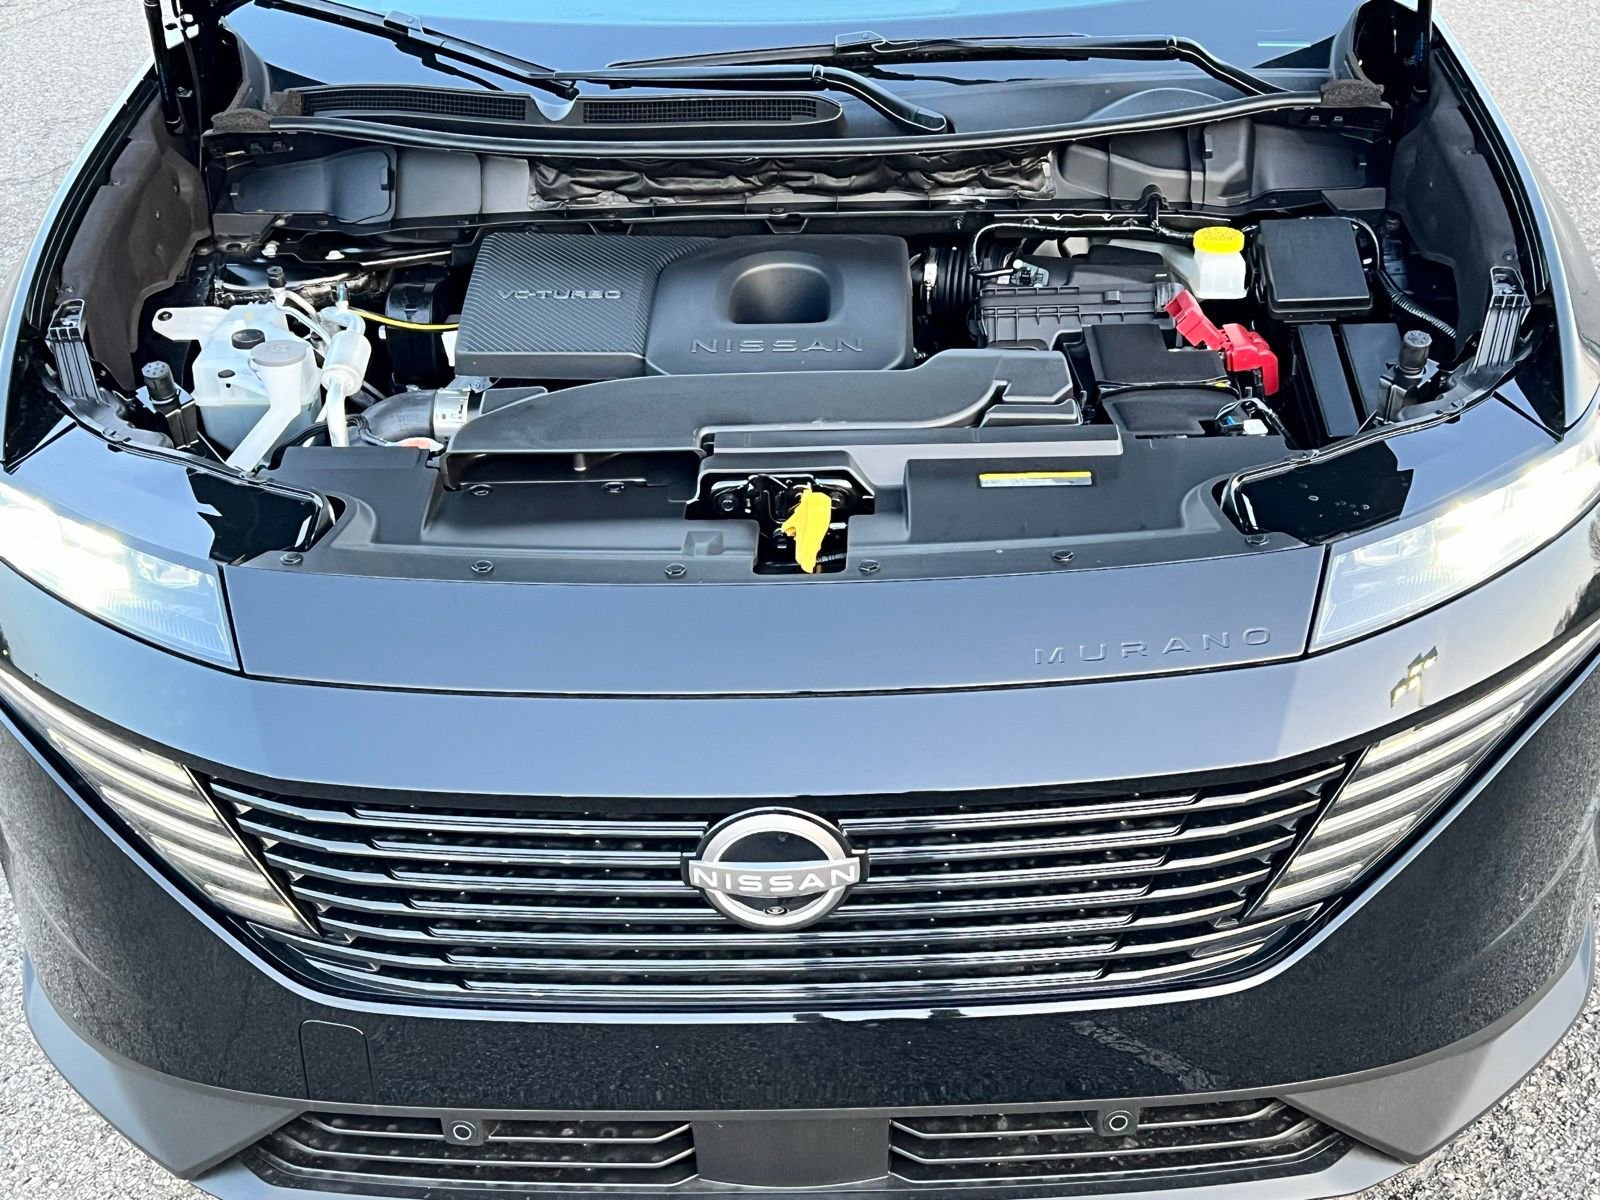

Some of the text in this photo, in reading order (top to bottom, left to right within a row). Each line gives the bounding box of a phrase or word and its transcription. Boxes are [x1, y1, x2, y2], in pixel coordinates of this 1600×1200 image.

[691, 338, 863, 353] NISSAN
[1034, 627, 1271, 665] MURANO
[693, 865, 855, 892] NISSAN
